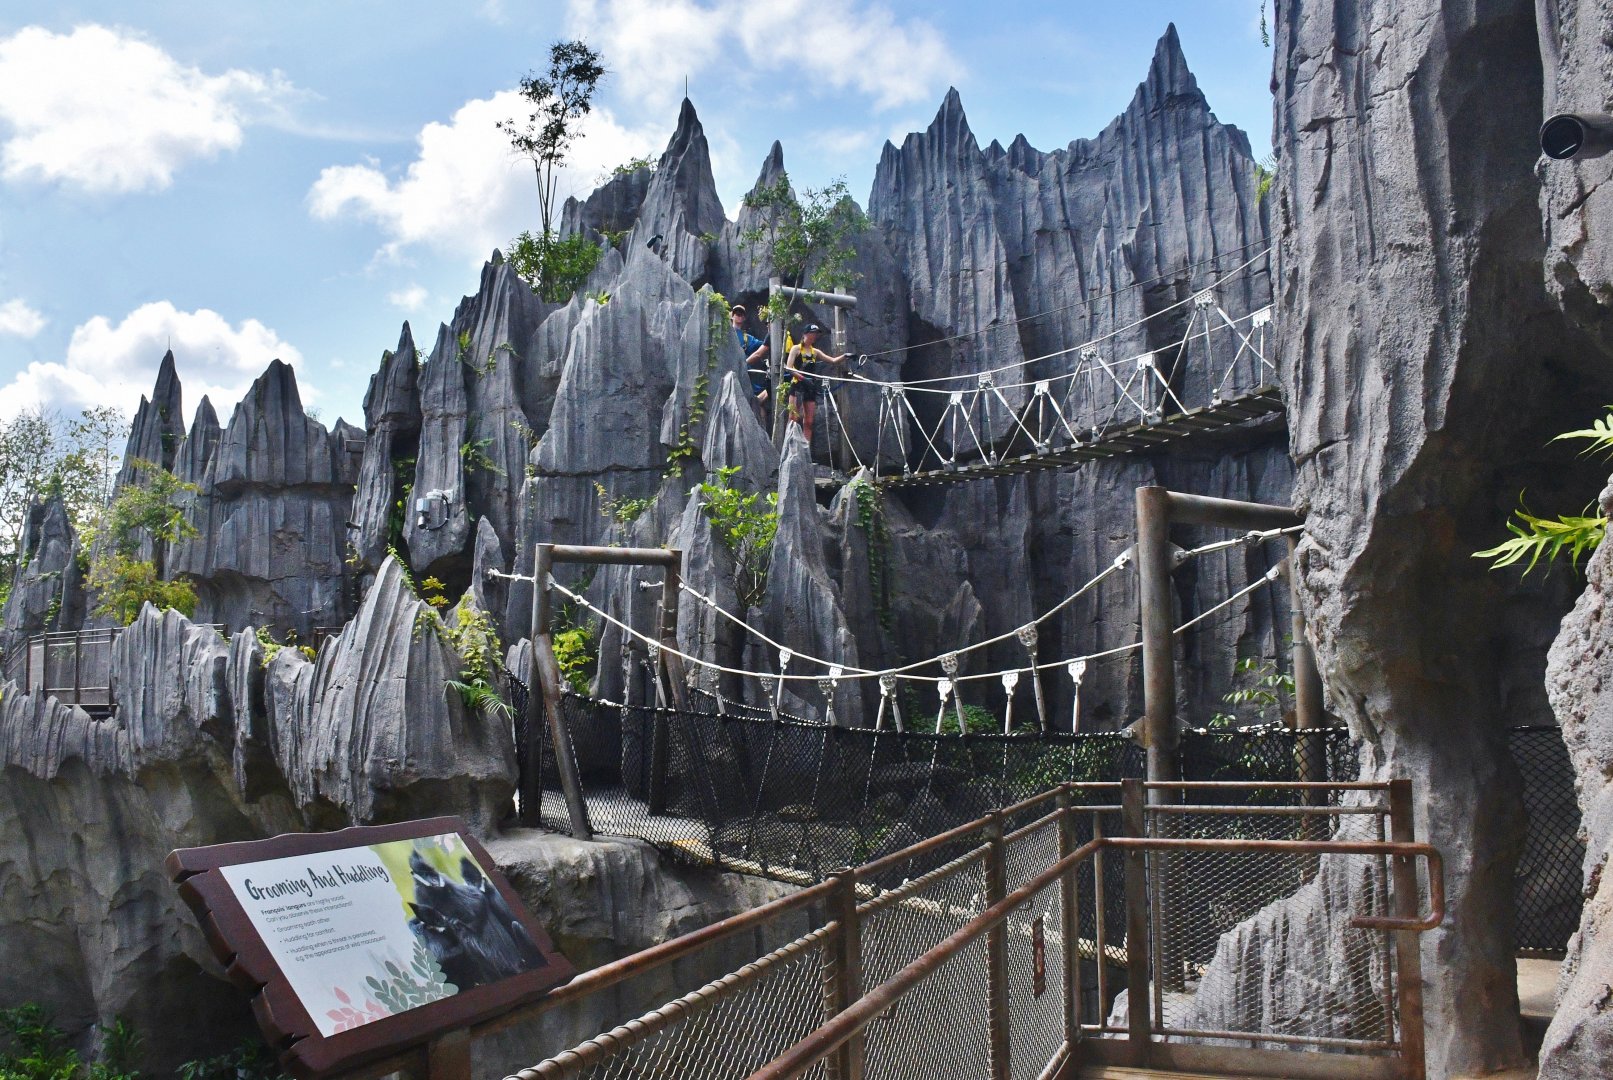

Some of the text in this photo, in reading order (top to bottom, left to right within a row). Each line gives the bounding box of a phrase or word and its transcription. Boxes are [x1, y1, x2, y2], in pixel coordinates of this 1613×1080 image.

[244, 865, 390, 901] Grooming And Huddling
[285, 903, 307, 911] langurs
